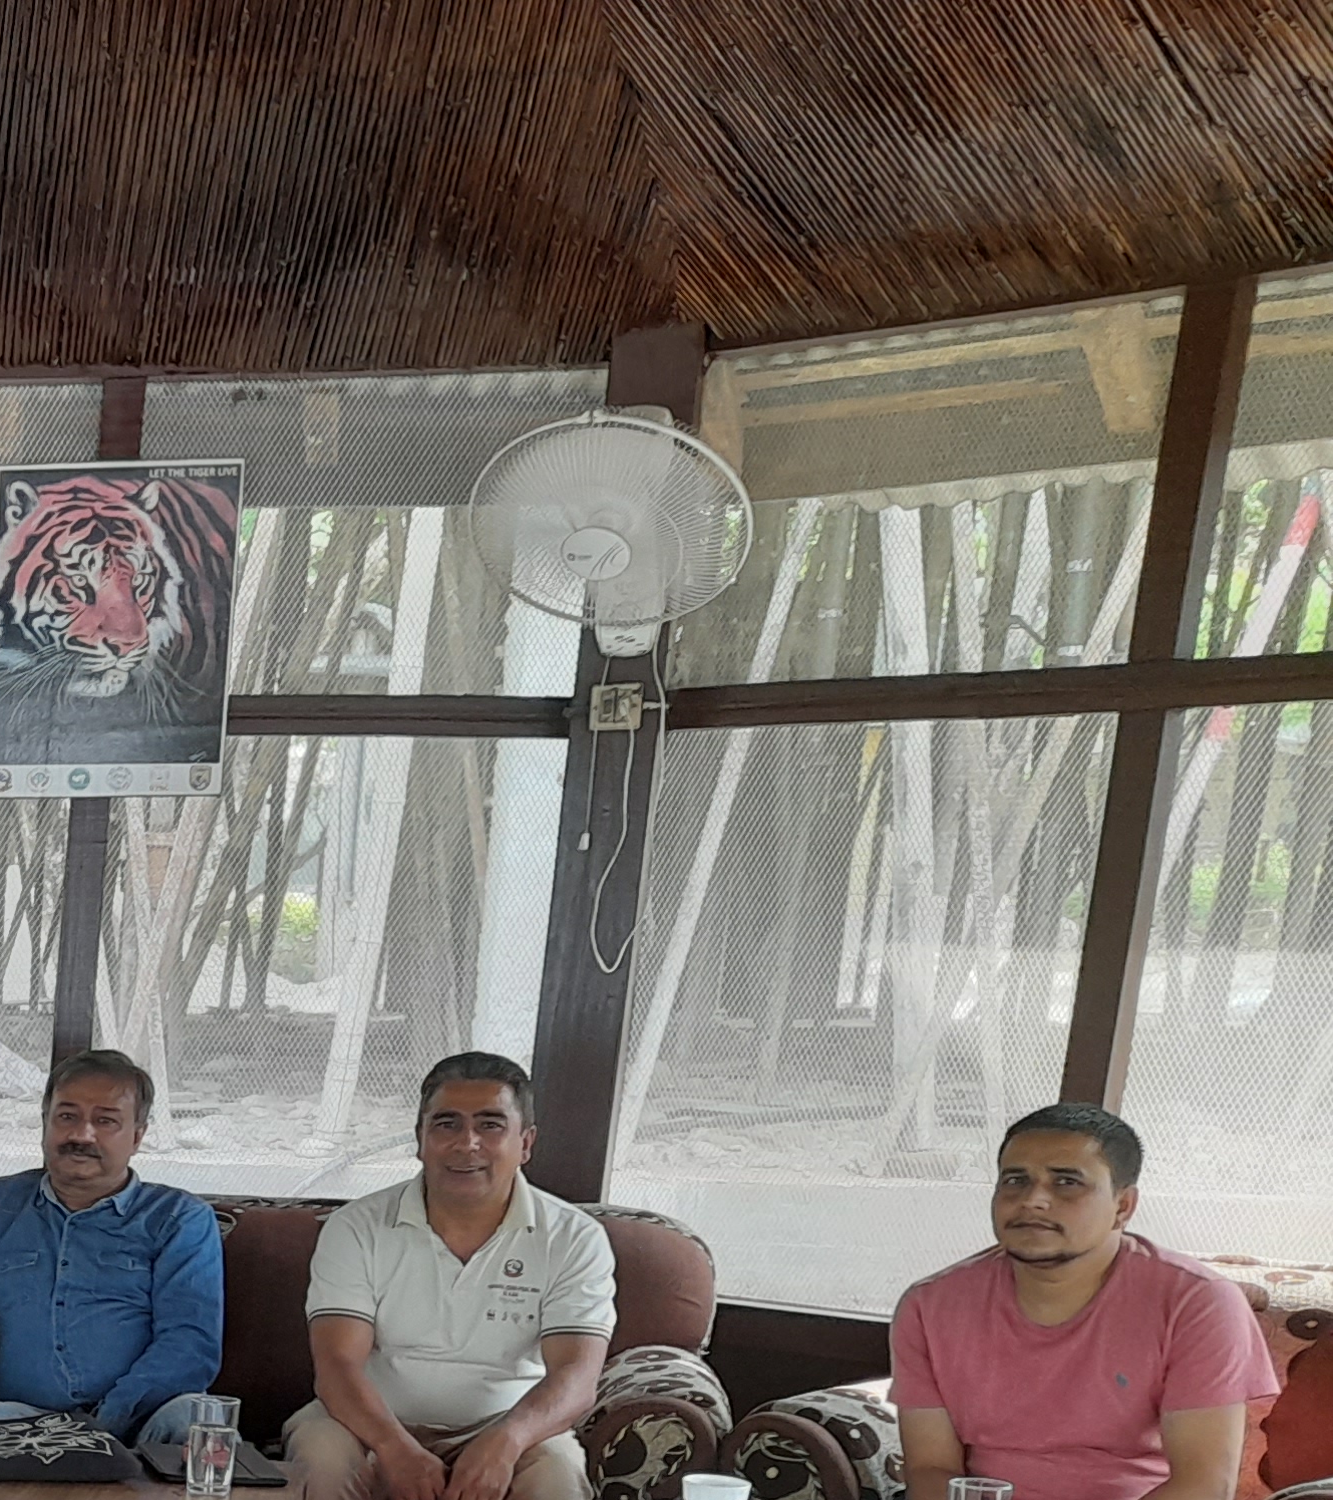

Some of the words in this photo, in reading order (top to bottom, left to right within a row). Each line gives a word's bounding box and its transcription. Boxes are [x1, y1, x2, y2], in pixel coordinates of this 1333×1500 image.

[148, 468, 166, 478] LET
[168, 467, 186, 477] THE
[188, 466, 216, 477] TIGER
[218, 466, 238, 477] LIVE
